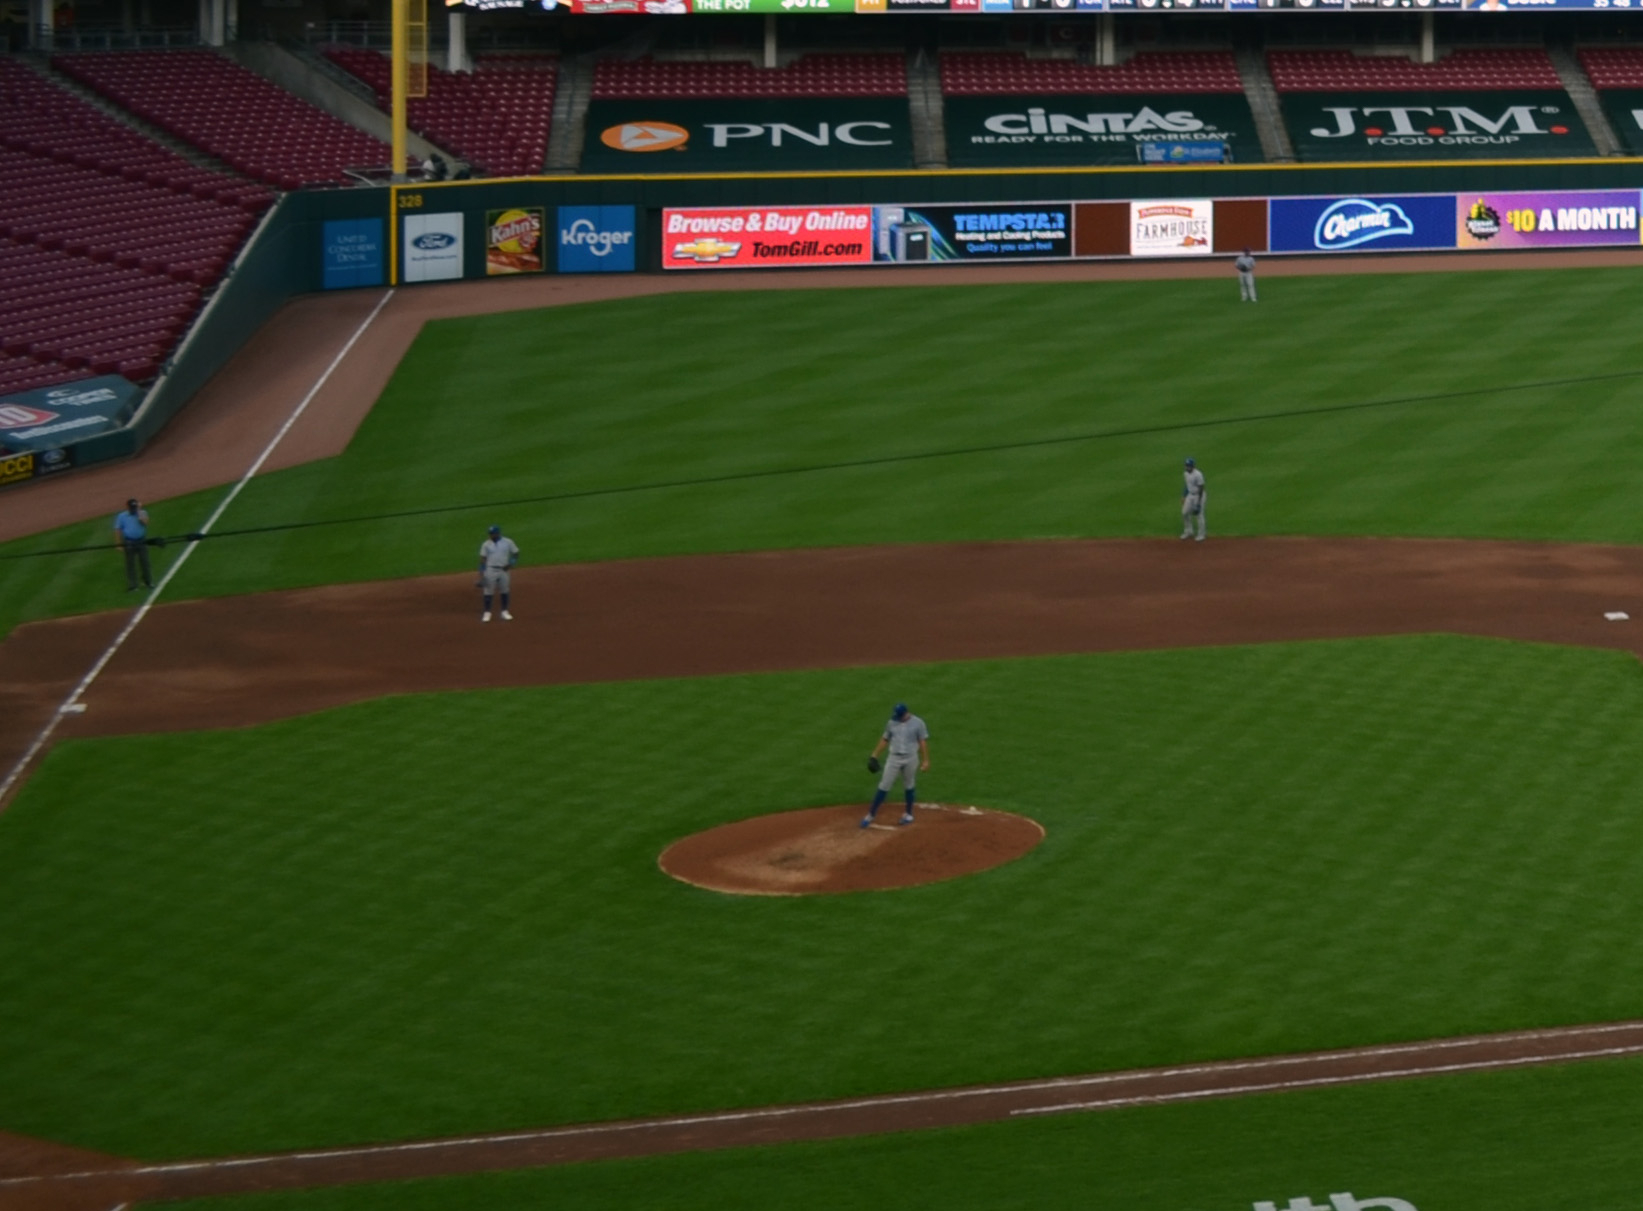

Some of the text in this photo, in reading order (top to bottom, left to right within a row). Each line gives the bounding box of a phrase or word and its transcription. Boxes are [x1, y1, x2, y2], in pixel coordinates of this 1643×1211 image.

[697, 0, 751, 11] THE POT
[704, 122, 892, 147] PNC
[971, 132, 1229, 143] READY WORKDAY
[491, 217, 540, 242] Kahn's
[668, 211, 868, 233] Browse Buy Online
[1136, 220, 1207, 239] FARMHOUSE
[1323, 208, 1390, 240] Charmin
[1507, 209, 1535, 232] $10
[1538, 209, 1555, 230] A
[1558, 207, 1636, 230] MONTH
[417, 235, 449, 250] Ford
[561, 219, 632, 256] Kroger
[752, 240, 862, 258] TomGill.com
